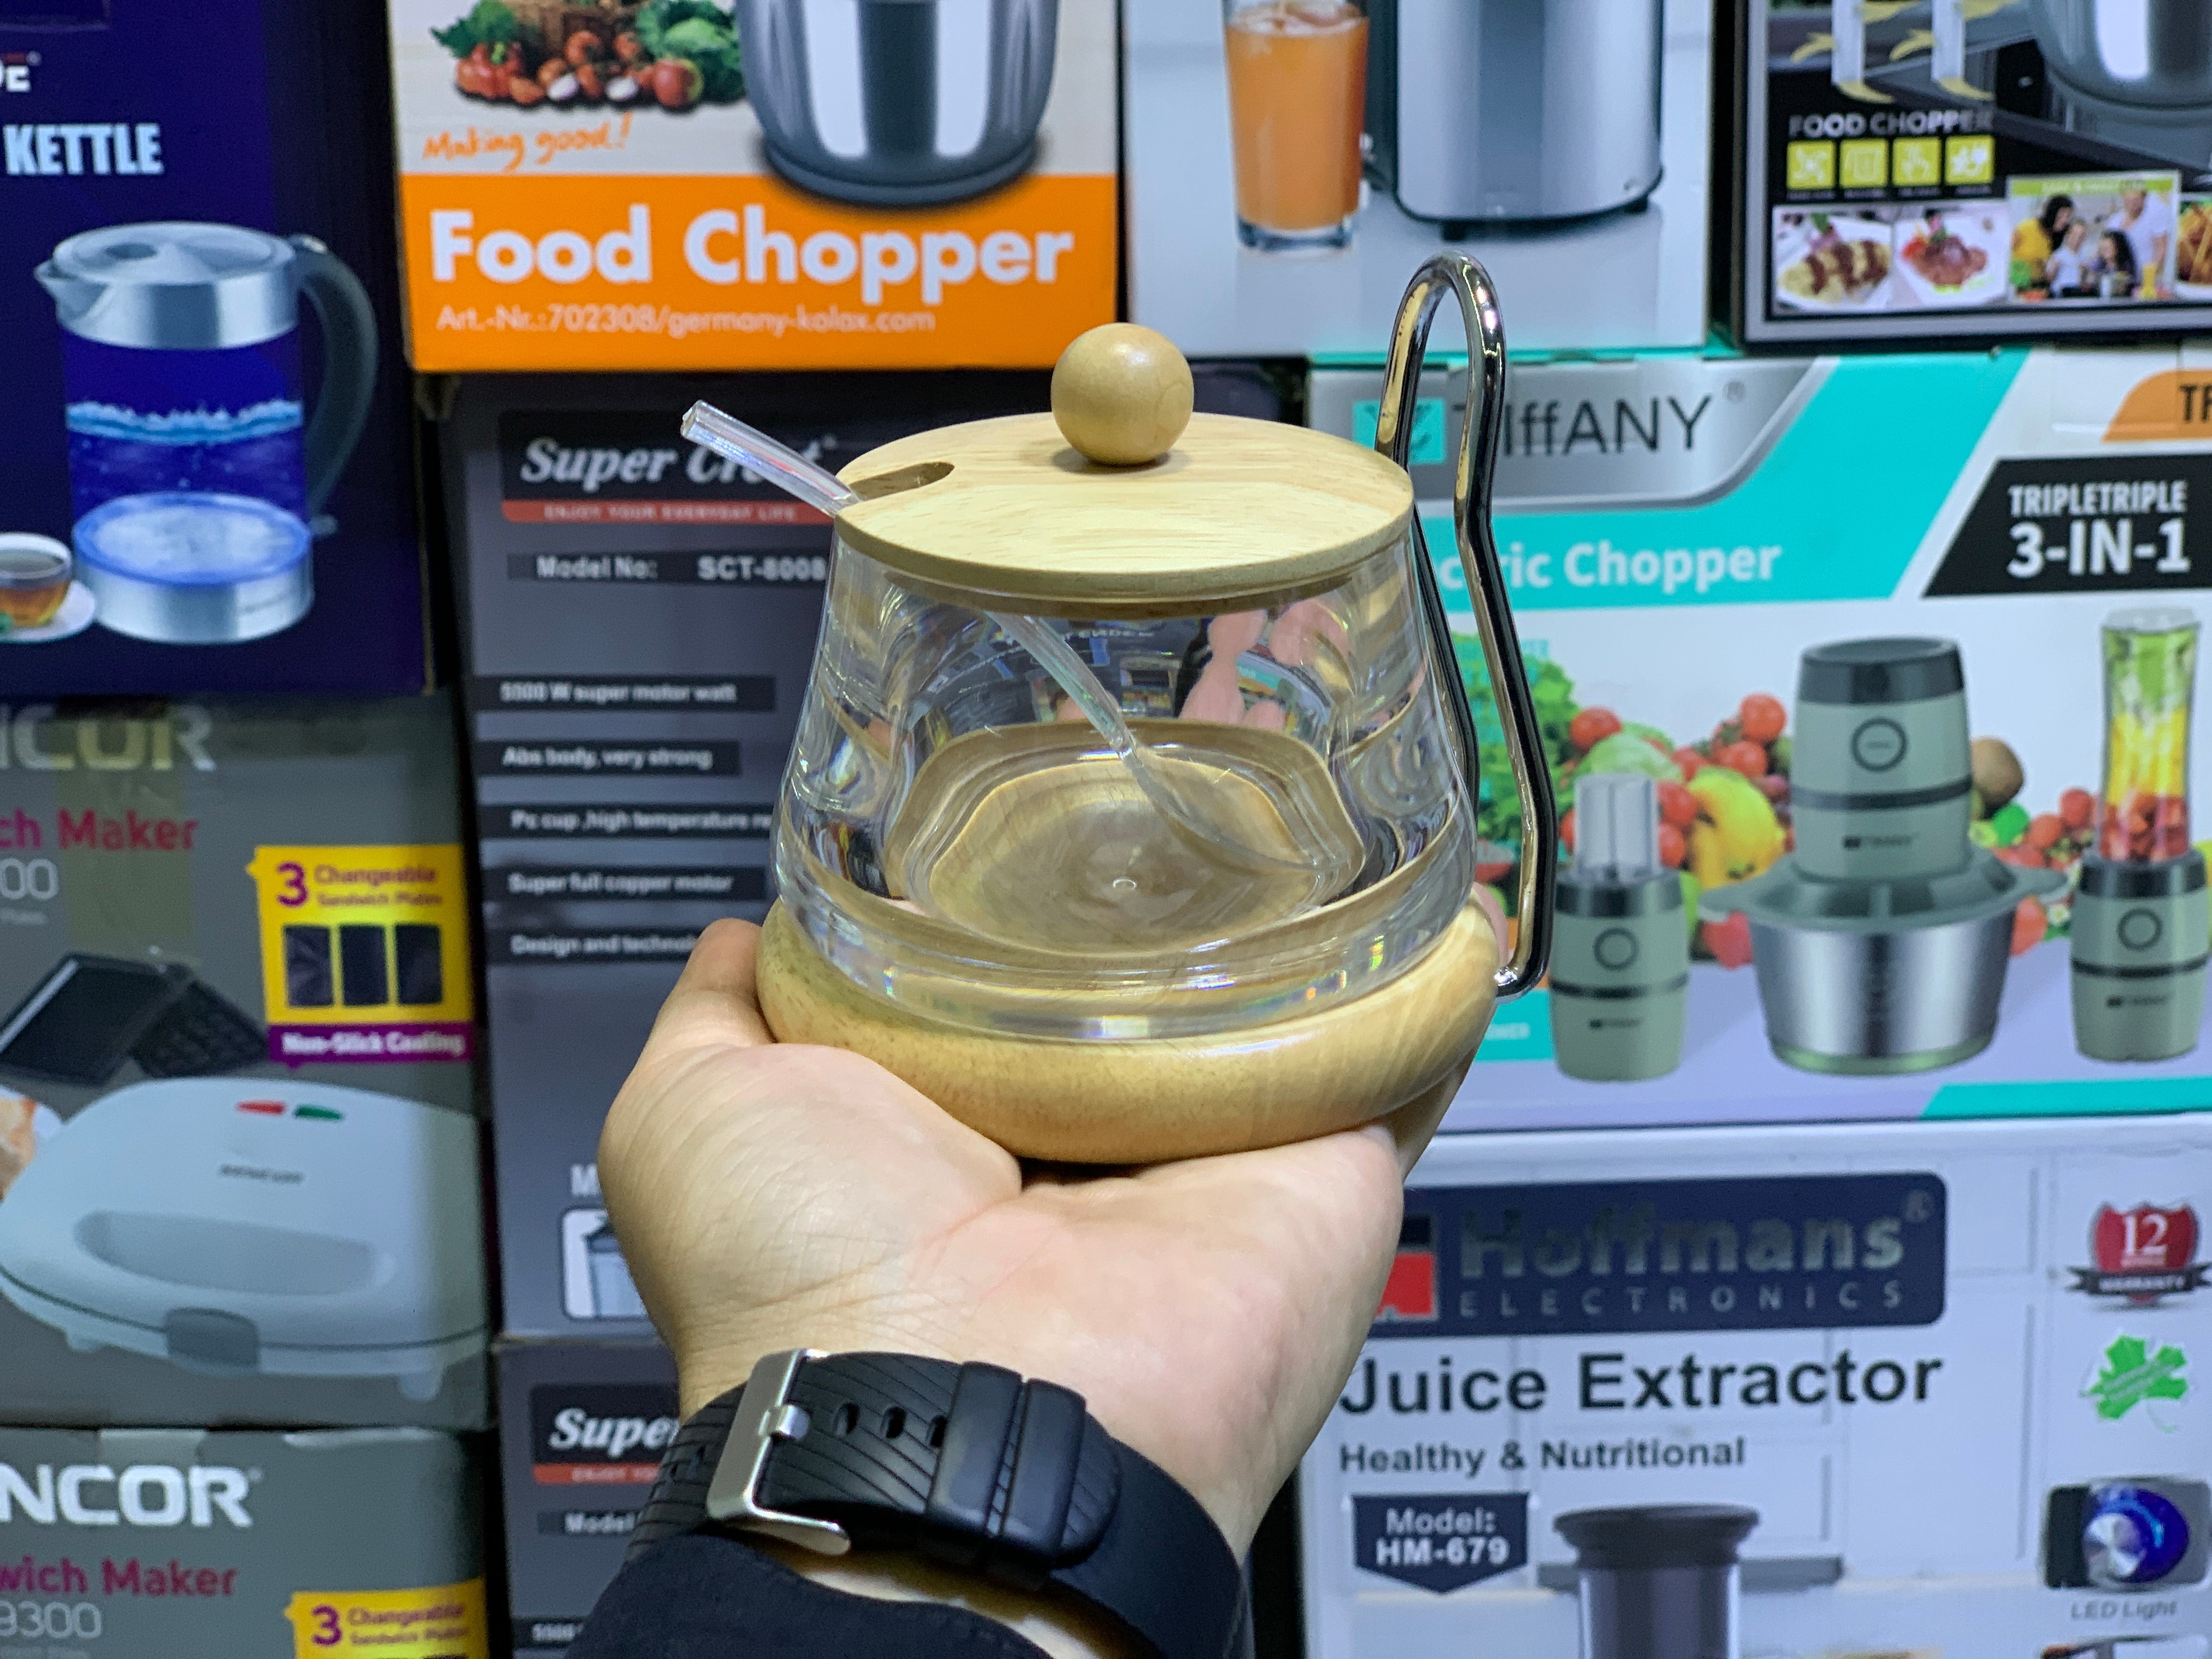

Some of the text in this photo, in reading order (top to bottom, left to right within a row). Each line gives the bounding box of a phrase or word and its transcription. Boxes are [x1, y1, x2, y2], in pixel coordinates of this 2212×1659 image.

[421, 112, 633, 172] Making good!
[1788, 114, 1866, 138] FOOD
[3, 123, 163, 176] KETTLE
[430, 202, 1074, 306] Food Chopper
[520, 437, 680, 493] Super
[2007, 479, 2189, 518] TRIPLETRIPLE
[537, 556, 611, 580] Model
[614, 556, 658, 580] No:
[1565, 540, 1782, 594] Chopper
[2006, 517, 2192, 579] 3-IN-1
[573, 684, 629, 704] super
[632, 684, 690, 703] motor
[601, 750, 644, 770] very
[647, 747, 713, 770] strong
[57, 806, 200, 853] Maker
[276, 860, 309, 907] 3
[508, 872, 567, 895] Super
[582, 935, 621, 955] and
[1459, 1207, 1905, 1278] Hoffmans
[2123, 1212, 2168, 1256] 12
[1338, 1349, 1944, 1415] Juice Extractor
[1339, 1436, 1747, 1479] Healthy & Nutritional
[1385, 1507, 1498, 1536] Model:
[1375, 1537, 1510, 1566] HM-679
[101, 1556, 239, 1596] Maker
[311, 1604, 343, 1646] 3
[2070, 1599, 2178, 1621] LED Light
